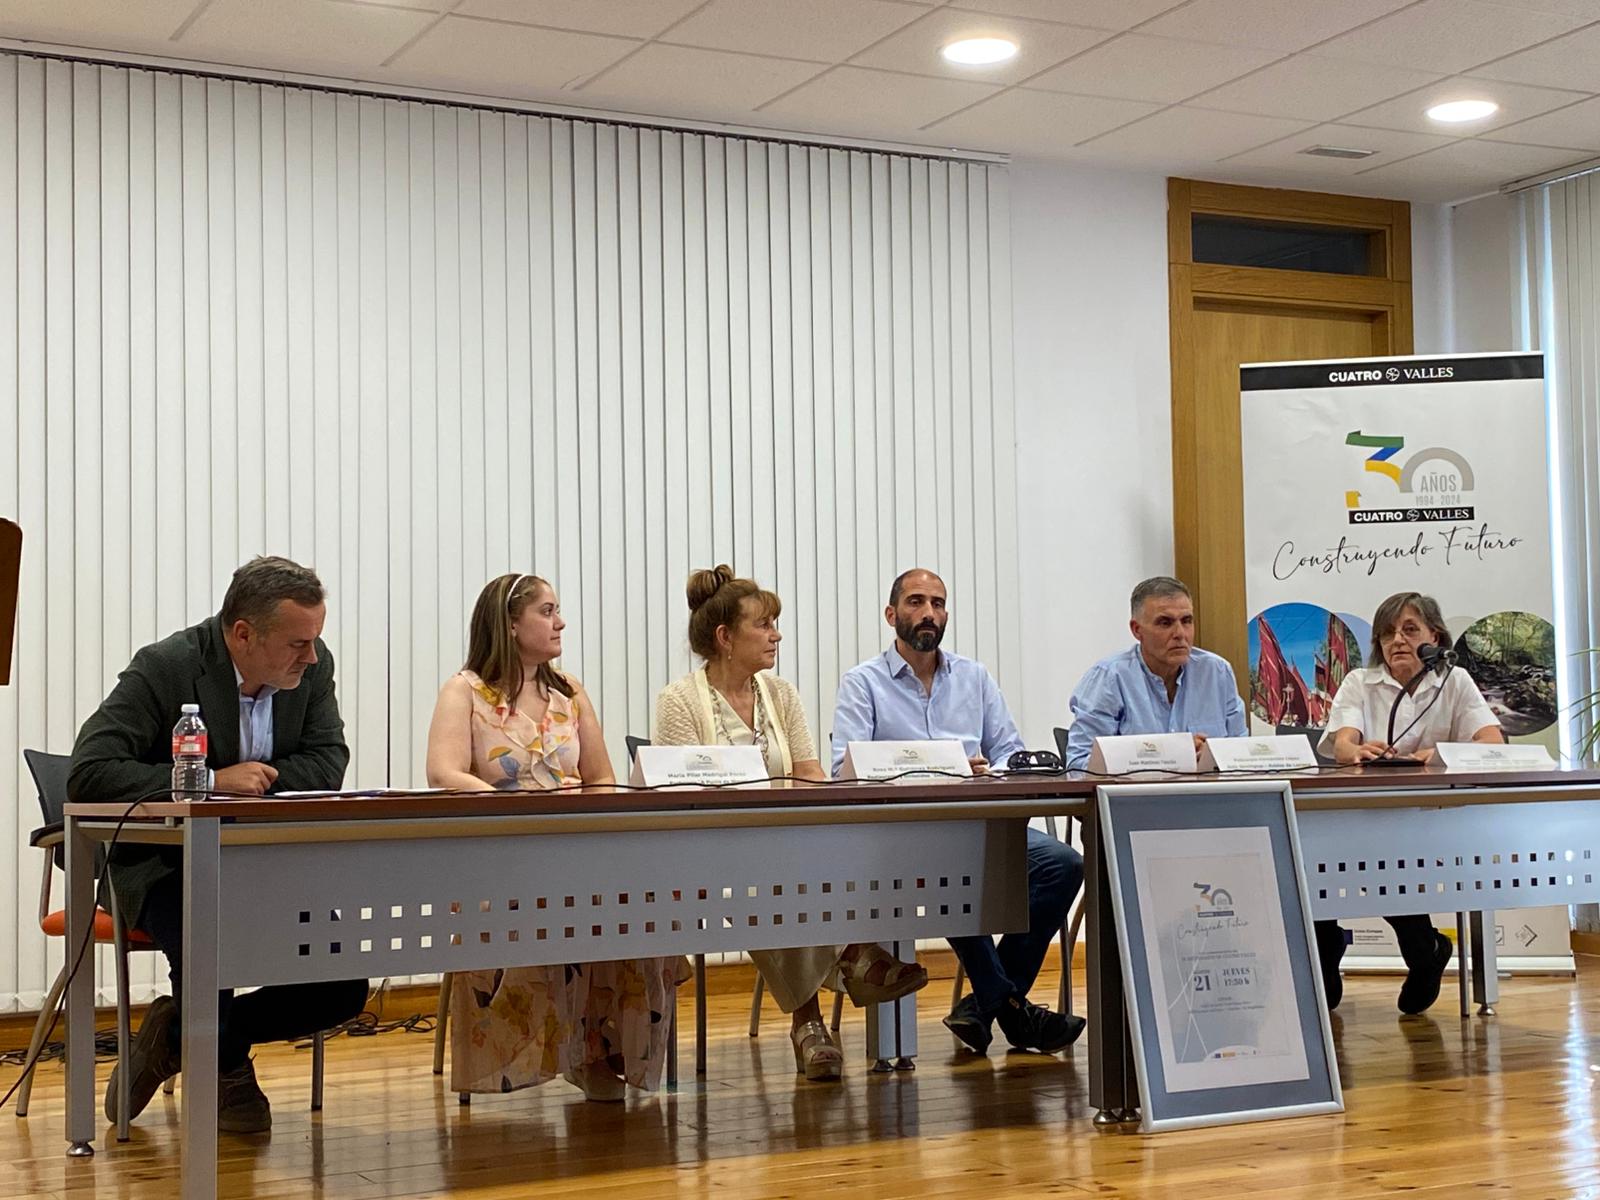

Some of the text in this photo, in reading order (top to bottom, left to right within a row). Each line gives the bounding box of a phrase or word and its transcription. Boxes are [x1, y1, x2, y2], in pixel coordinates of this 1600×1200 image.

[1328, 366, 1454, 383] CUATRO VALLES
[1420, 471, 1457, 493] AÑOS
[1354, 508, 1470, 522] CUATRO VALLES
[1272, 522, 1524, 581] Construyendo Futuro
[1193, 975, 1212, 991] 21
